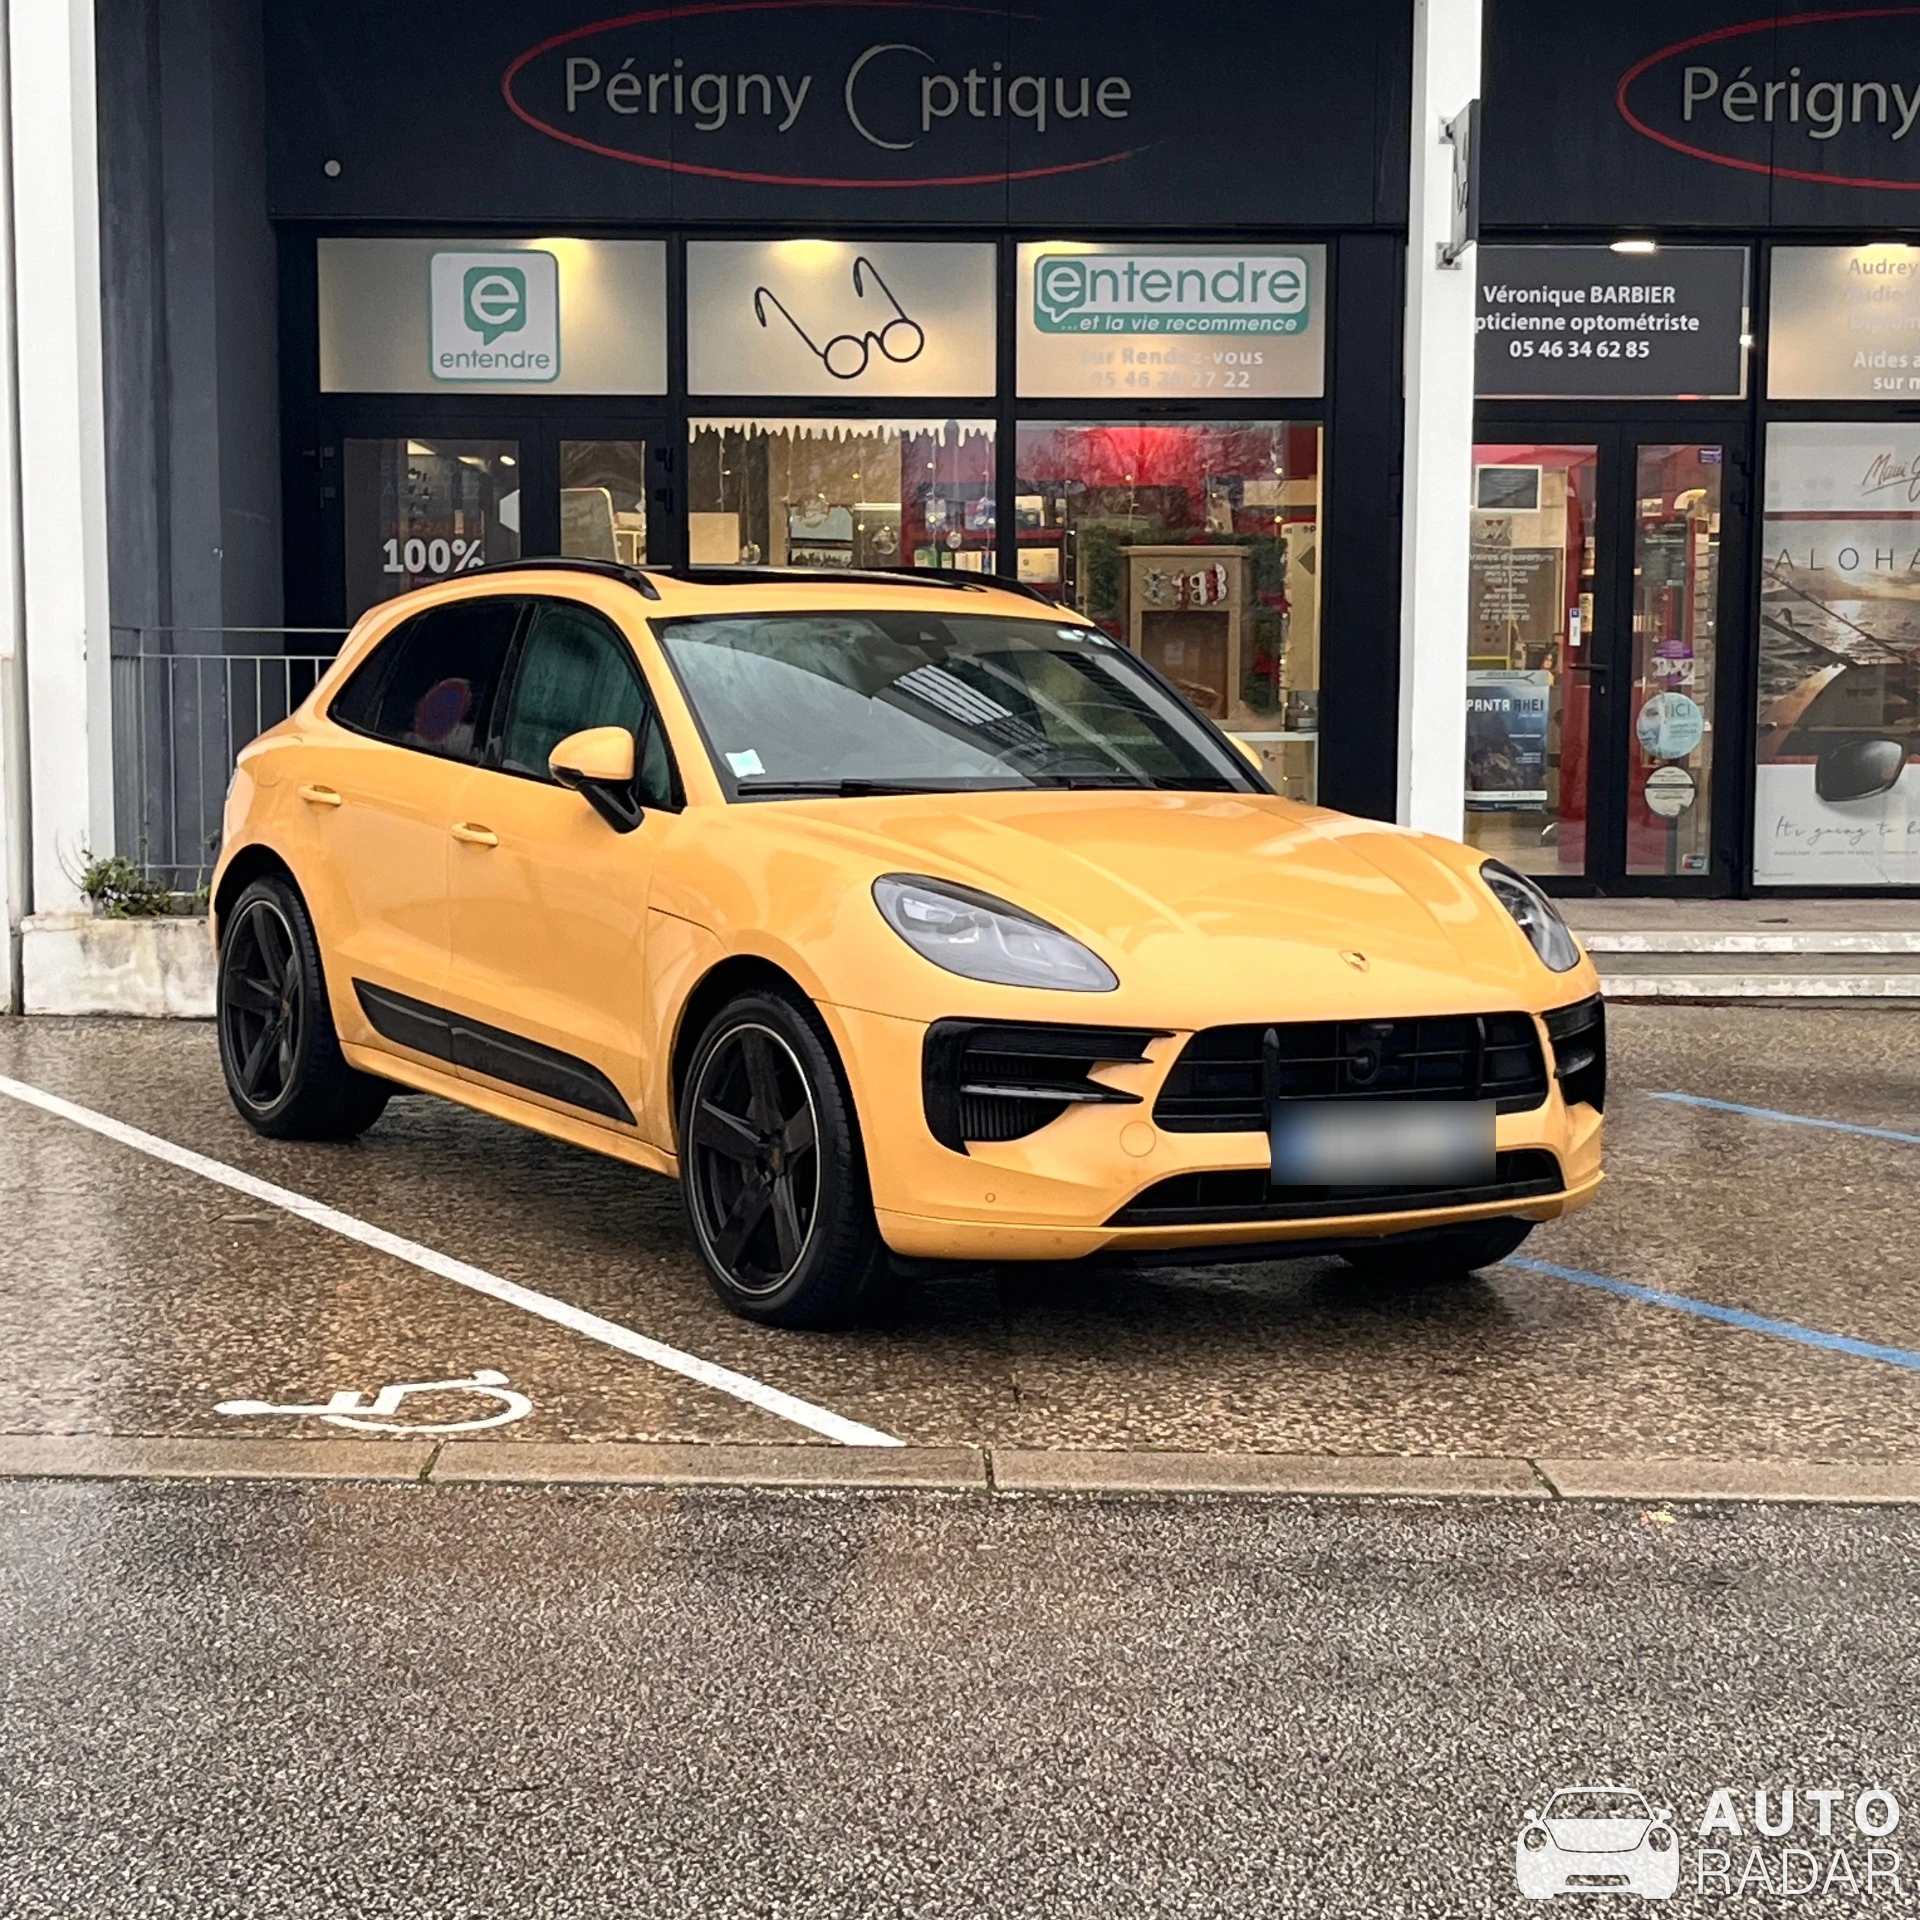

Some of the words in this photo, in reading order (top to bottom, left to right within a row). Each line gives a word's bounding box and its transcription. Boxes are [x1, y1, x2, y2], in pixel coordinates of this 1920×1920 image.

[565, 56, 811, 132] Périgny
[1682, 65, 1920, 140] Périgny
[1848, 258, 1920, 279] Audrey
[1046, 261, 1300, 303] entendre
[1483, 285, 1586, 307] Véronique
[1590, 286, 1676, 304] BARBIER
[1105, 315, 1124, 330] la
[1131, 316, 1160, 330] vie
[1165, 317, 1298, 331] recommence
[1475, 313, 1566, 334] pticienne
[1570, 313, 1700, 334] optométriste
[439, 350, 550, 369] entendre
[1509, 341, 1534, 358] 05
[1538, 341, 1563, 358] 46
[1567, 341, 1592, 358] 34
[1596, 341, 1621, 358] 62
[1625, 341, 1650, 358] 85
[1853, 350, 1908, 368] Aides
[1191, 371, 1217, 388] 27
[1223, 371, 1250, 388] 22
[1873, 376, 1903, 390] sur
[1861, 453, 1906, 486] Maui
[382, 538, 485, 574] 100%
[1466, 698, 1511, 712] PANTA
[1513, 698, 1544, 711] RHEI
